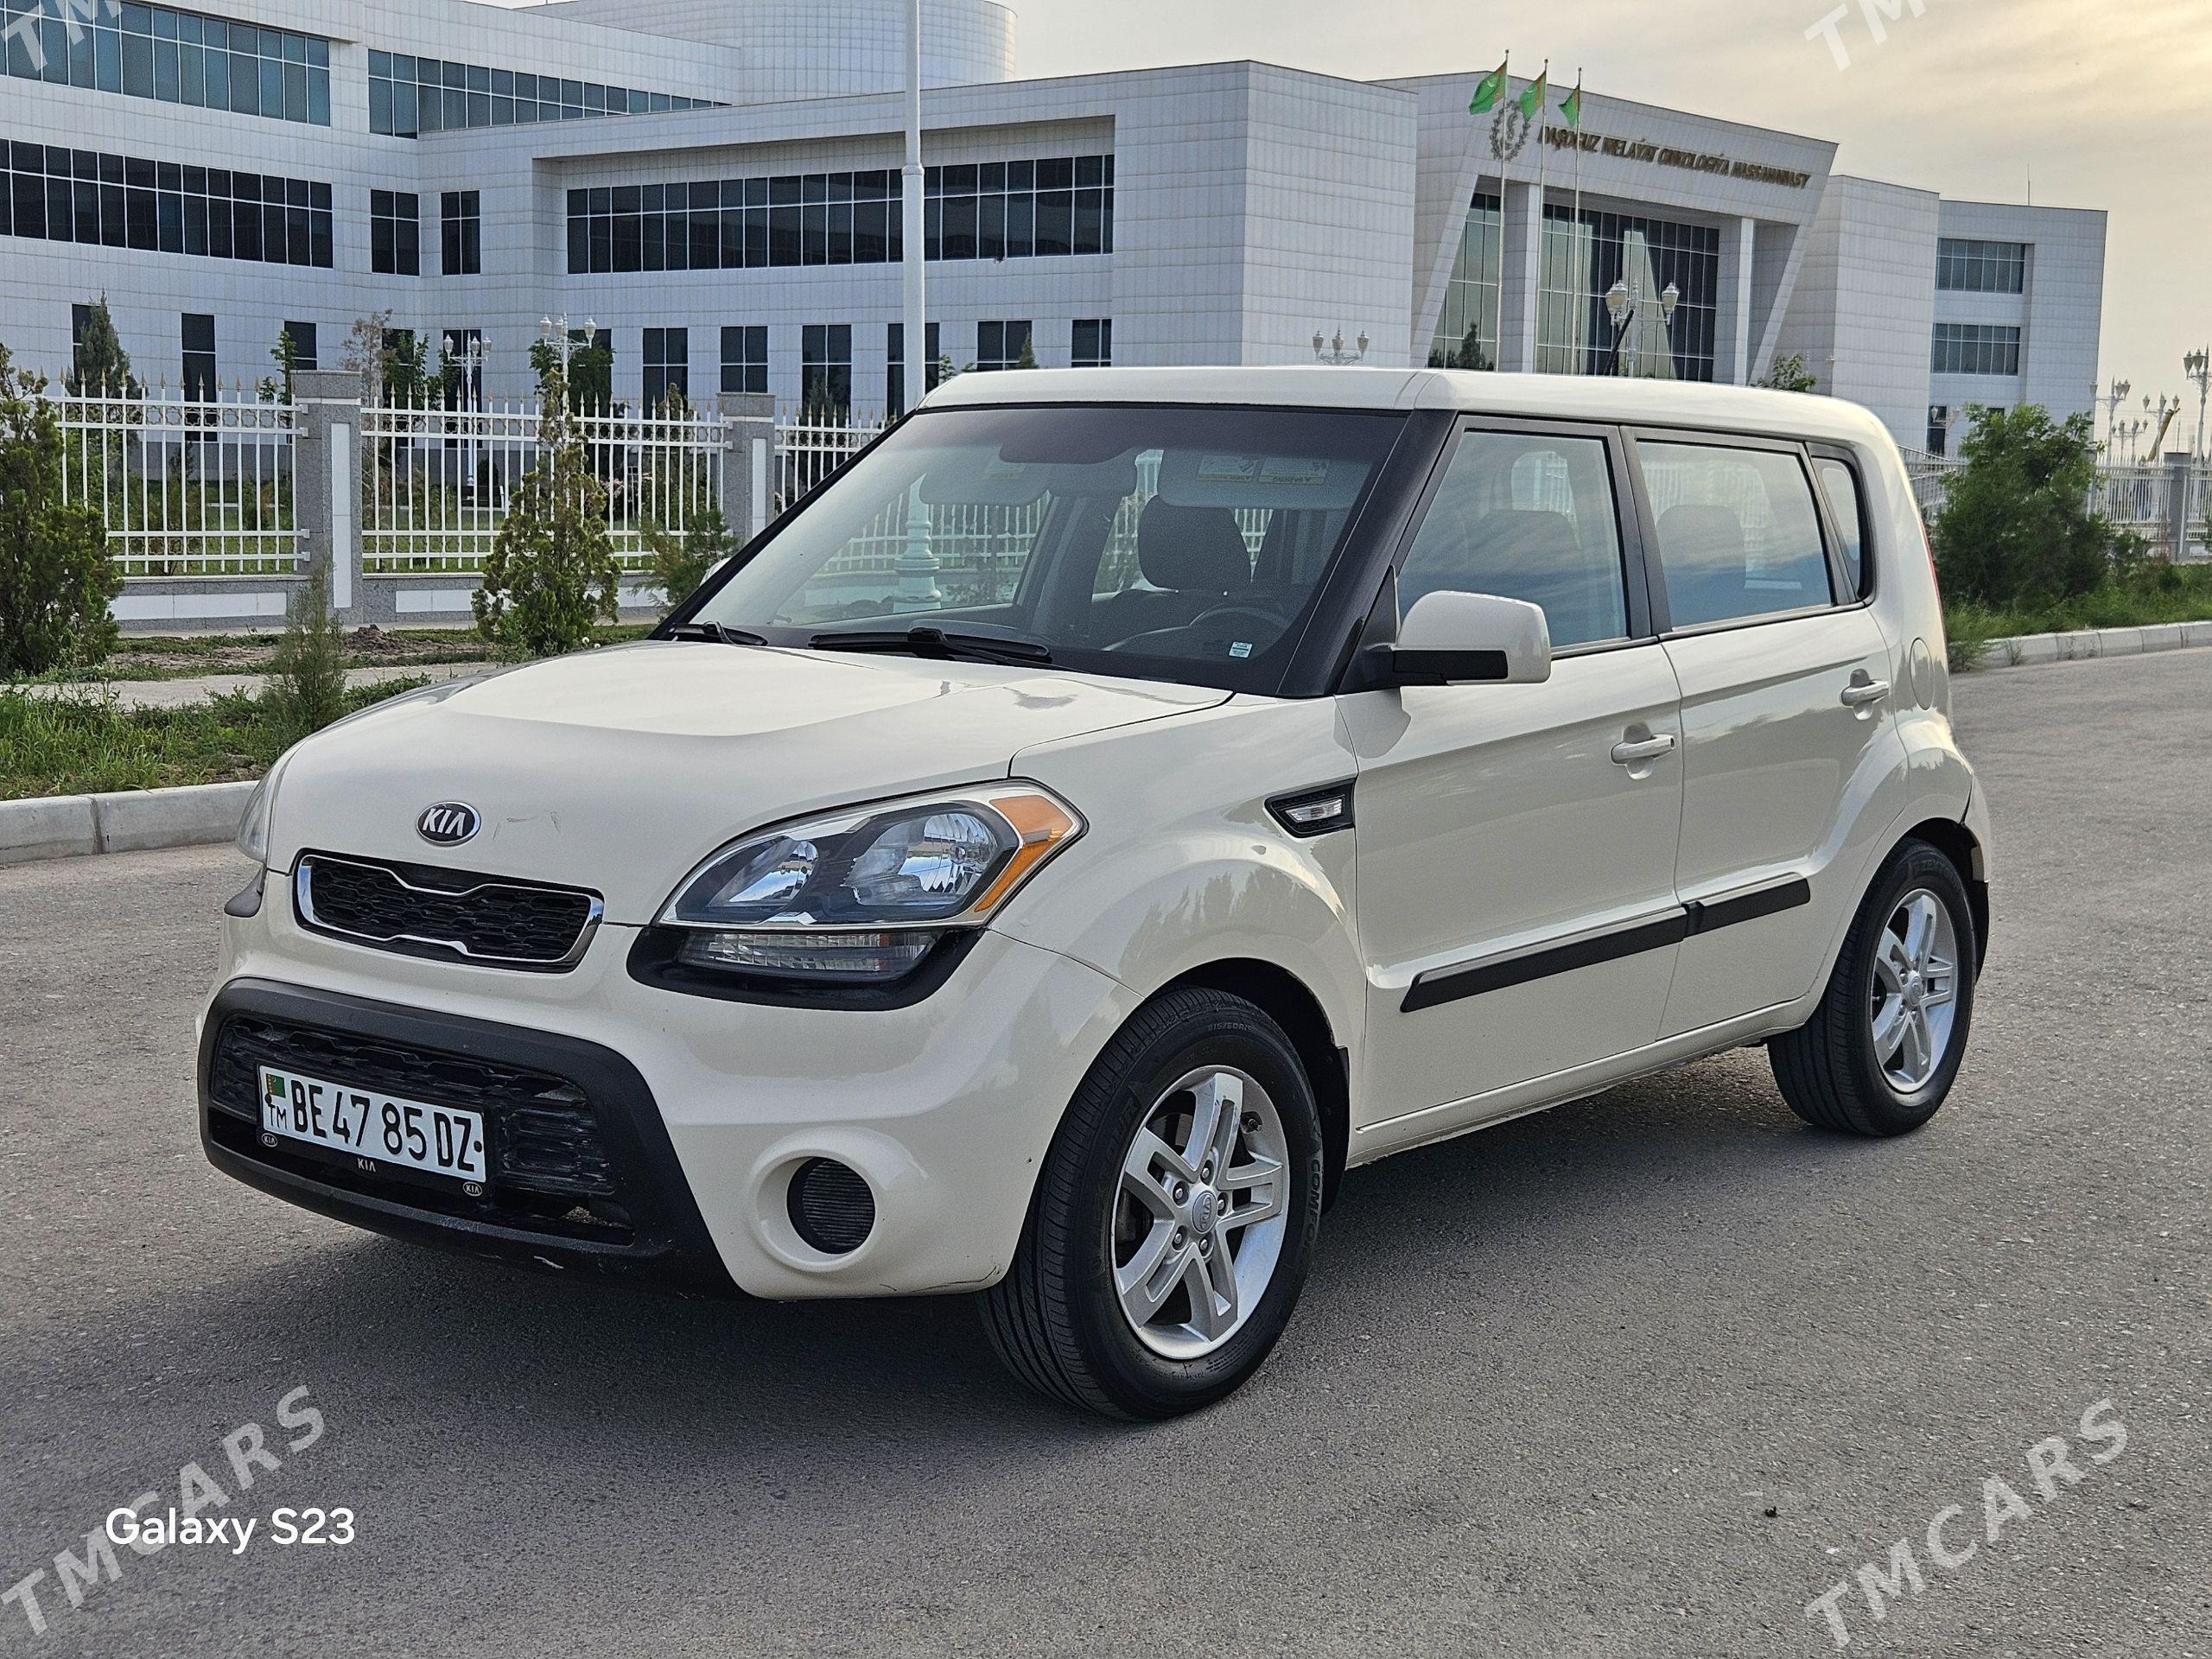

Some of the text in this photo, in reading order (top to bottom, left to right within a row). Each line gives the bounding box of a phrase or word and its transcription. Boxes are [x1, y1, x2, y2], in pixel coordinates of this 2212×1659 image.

[423, 808, 466, 836] KIA
[268, 1103, 288, 1130] TM
[264, 1135, 276, 1145] KIA
[357, 1158, 377, 1173] KIA
[466, 1184, 480, 1194] KIA
